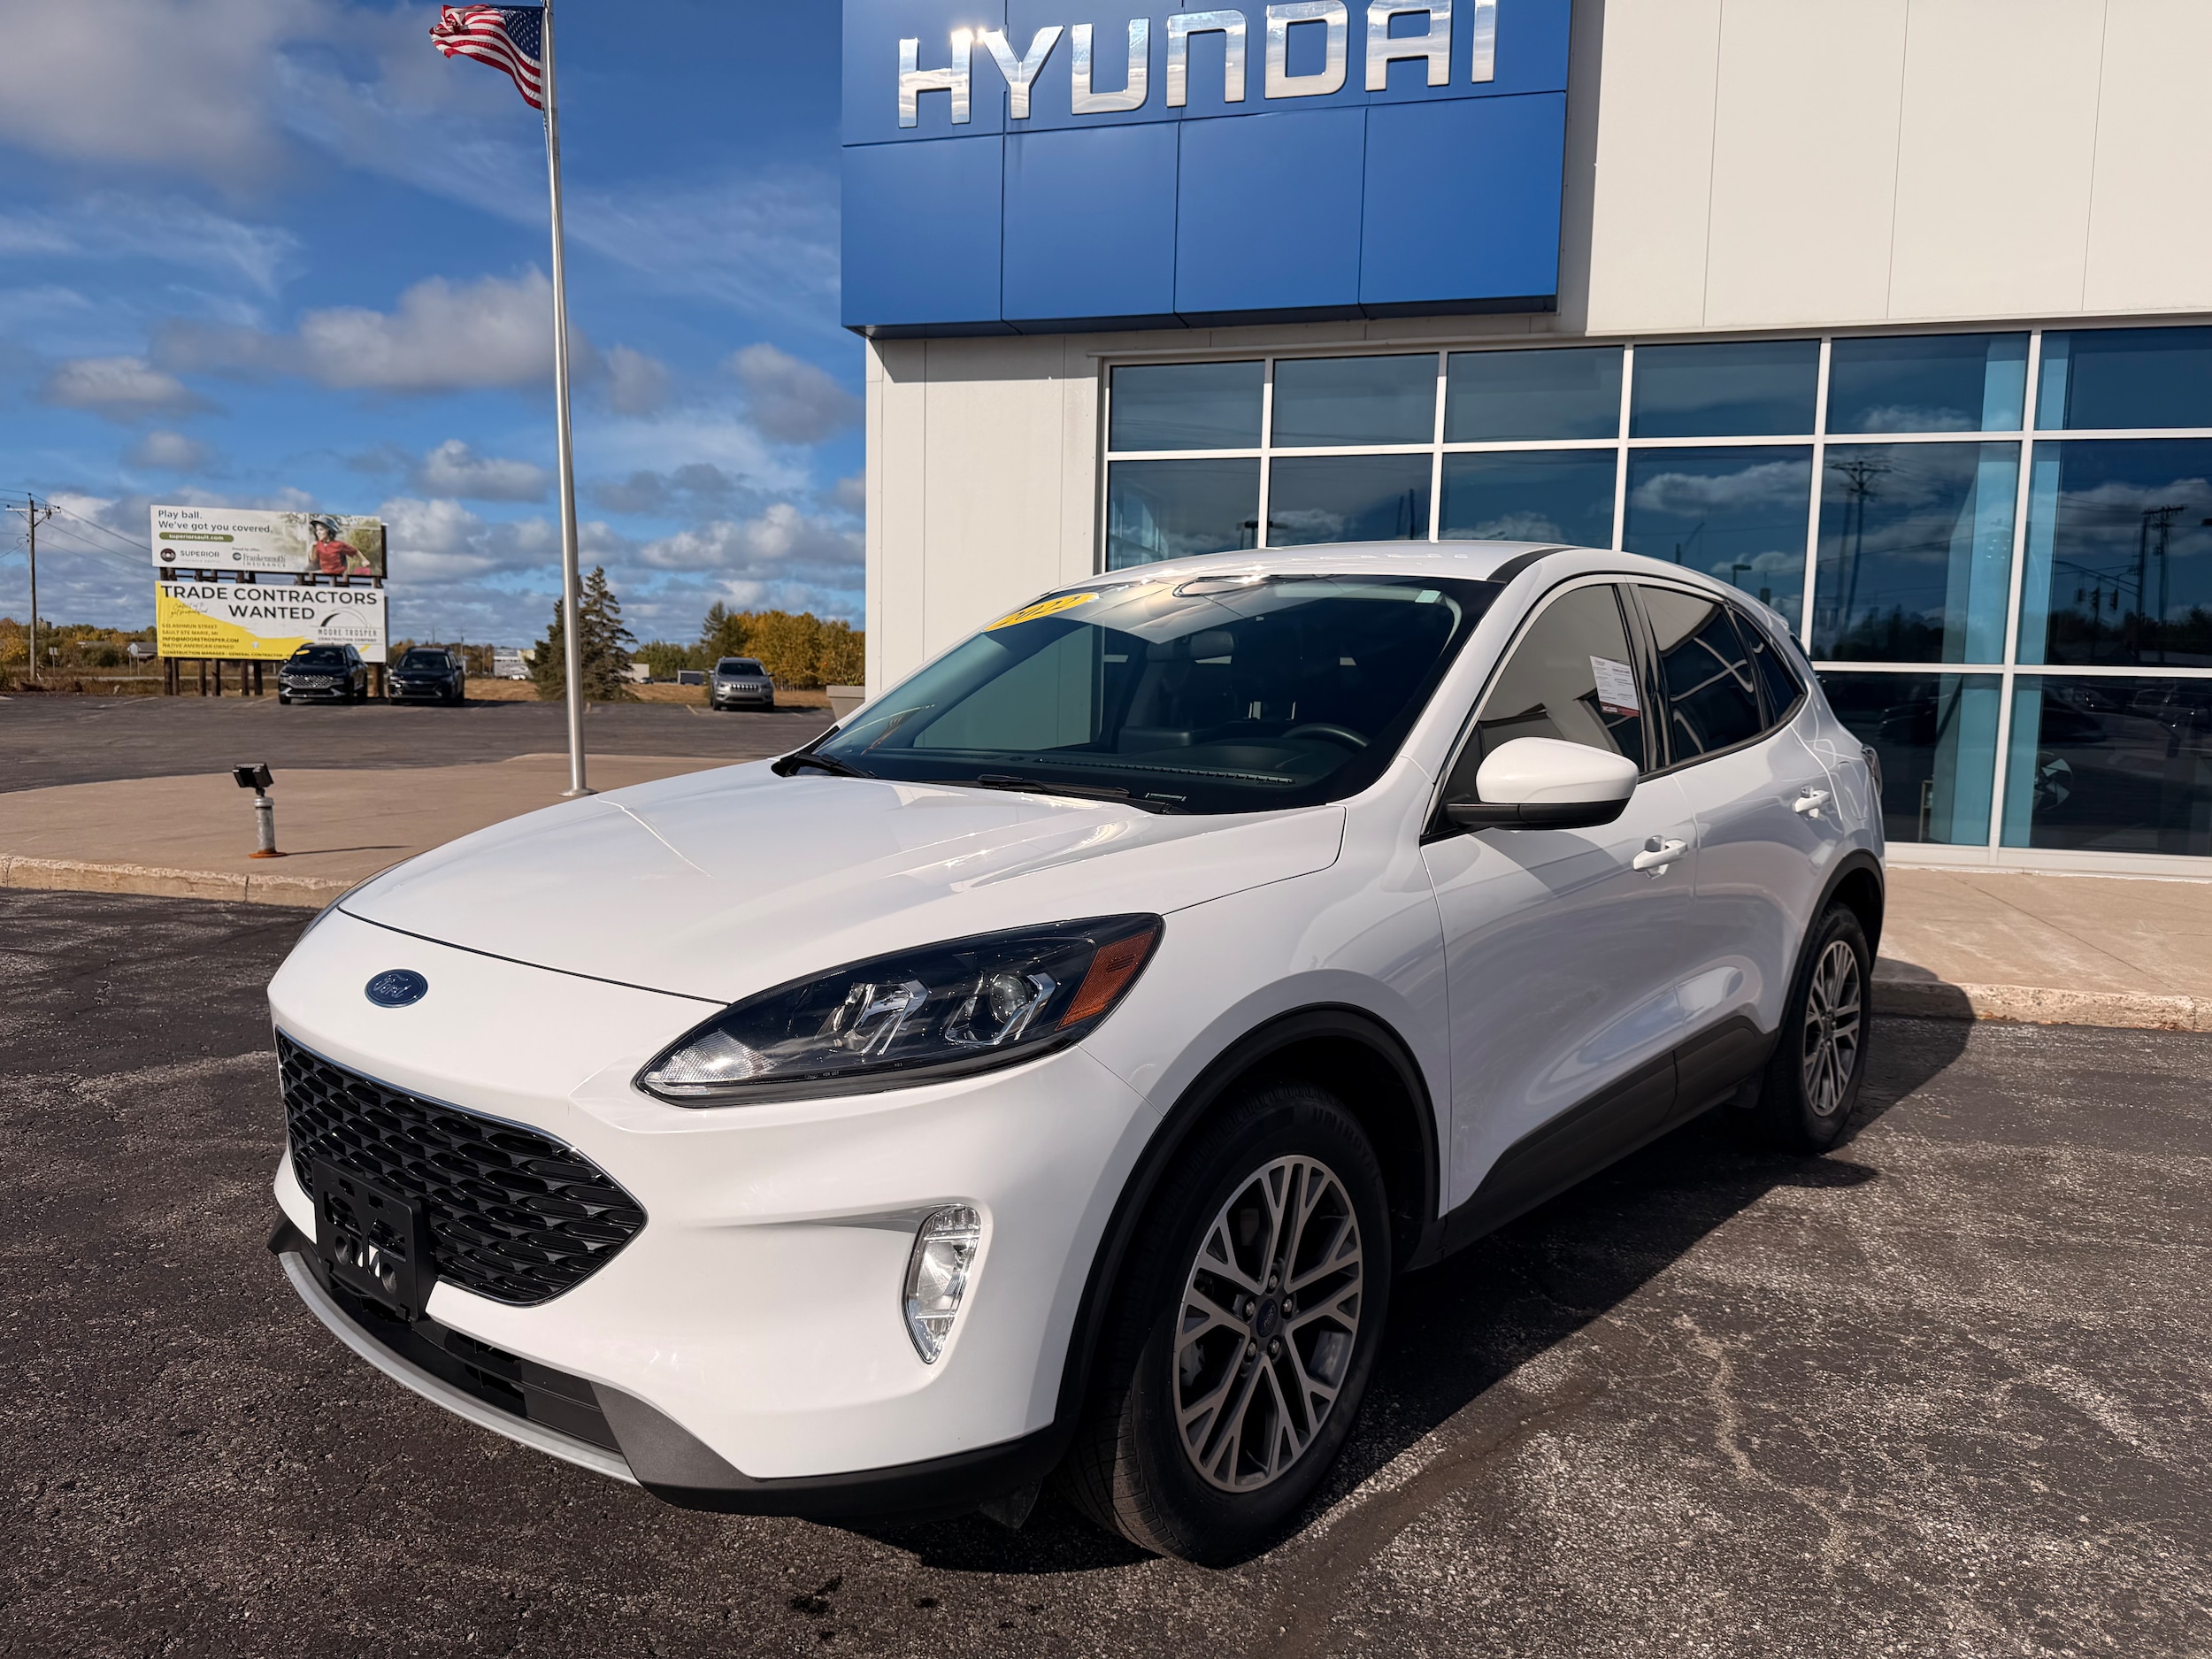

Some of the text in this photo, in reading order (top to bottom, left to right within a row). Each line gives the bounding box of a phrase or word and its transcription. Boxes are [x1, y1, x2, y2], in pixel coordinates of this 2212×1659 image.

[899, 0, 1496, 128] HYUNDAI
[158, 510, 203, 519] Play ball.
[158, 520, 188, 529] We've
[232, 525, 273, 534] covered.
[160, 585, 378, 605] TRADE CONTRACTORS
[228, 604, 315, 620] WANTED
